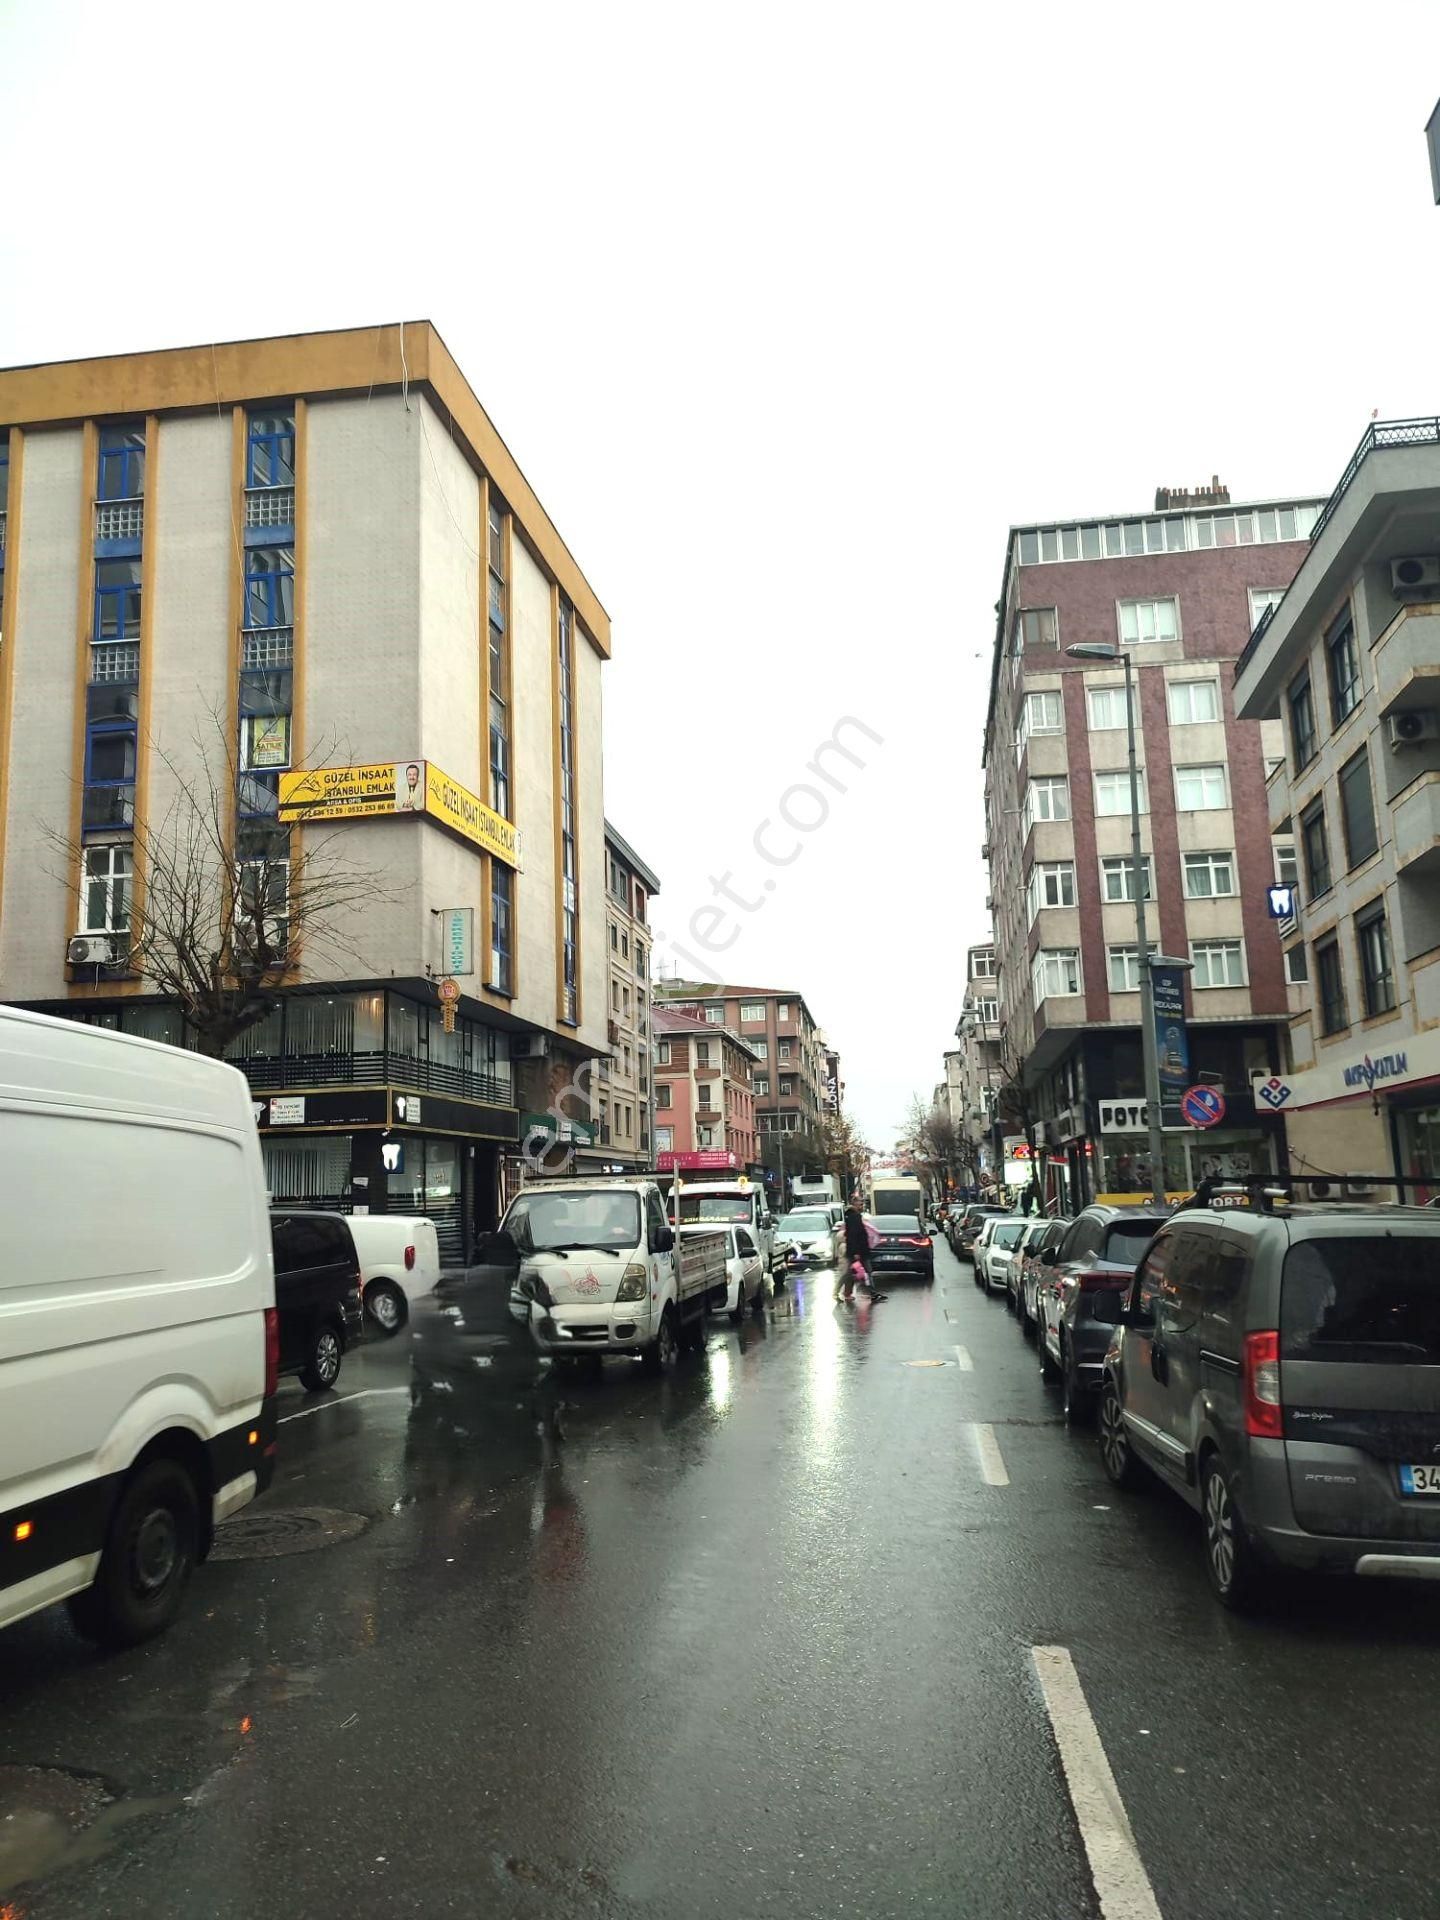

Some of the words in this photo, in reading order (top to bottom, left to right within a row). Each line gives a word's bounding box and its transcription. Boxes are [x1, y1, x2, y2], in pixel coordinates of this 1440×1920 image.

[324, 772, 355, 784] GÜZEL
[358, 768, 394, 781] İNŞAAT
[324, 786, 364, 798] İSTANBUL
[366, 783, 395, 793] EMLAK
[442, 780, 460, 816] GÜZEL
